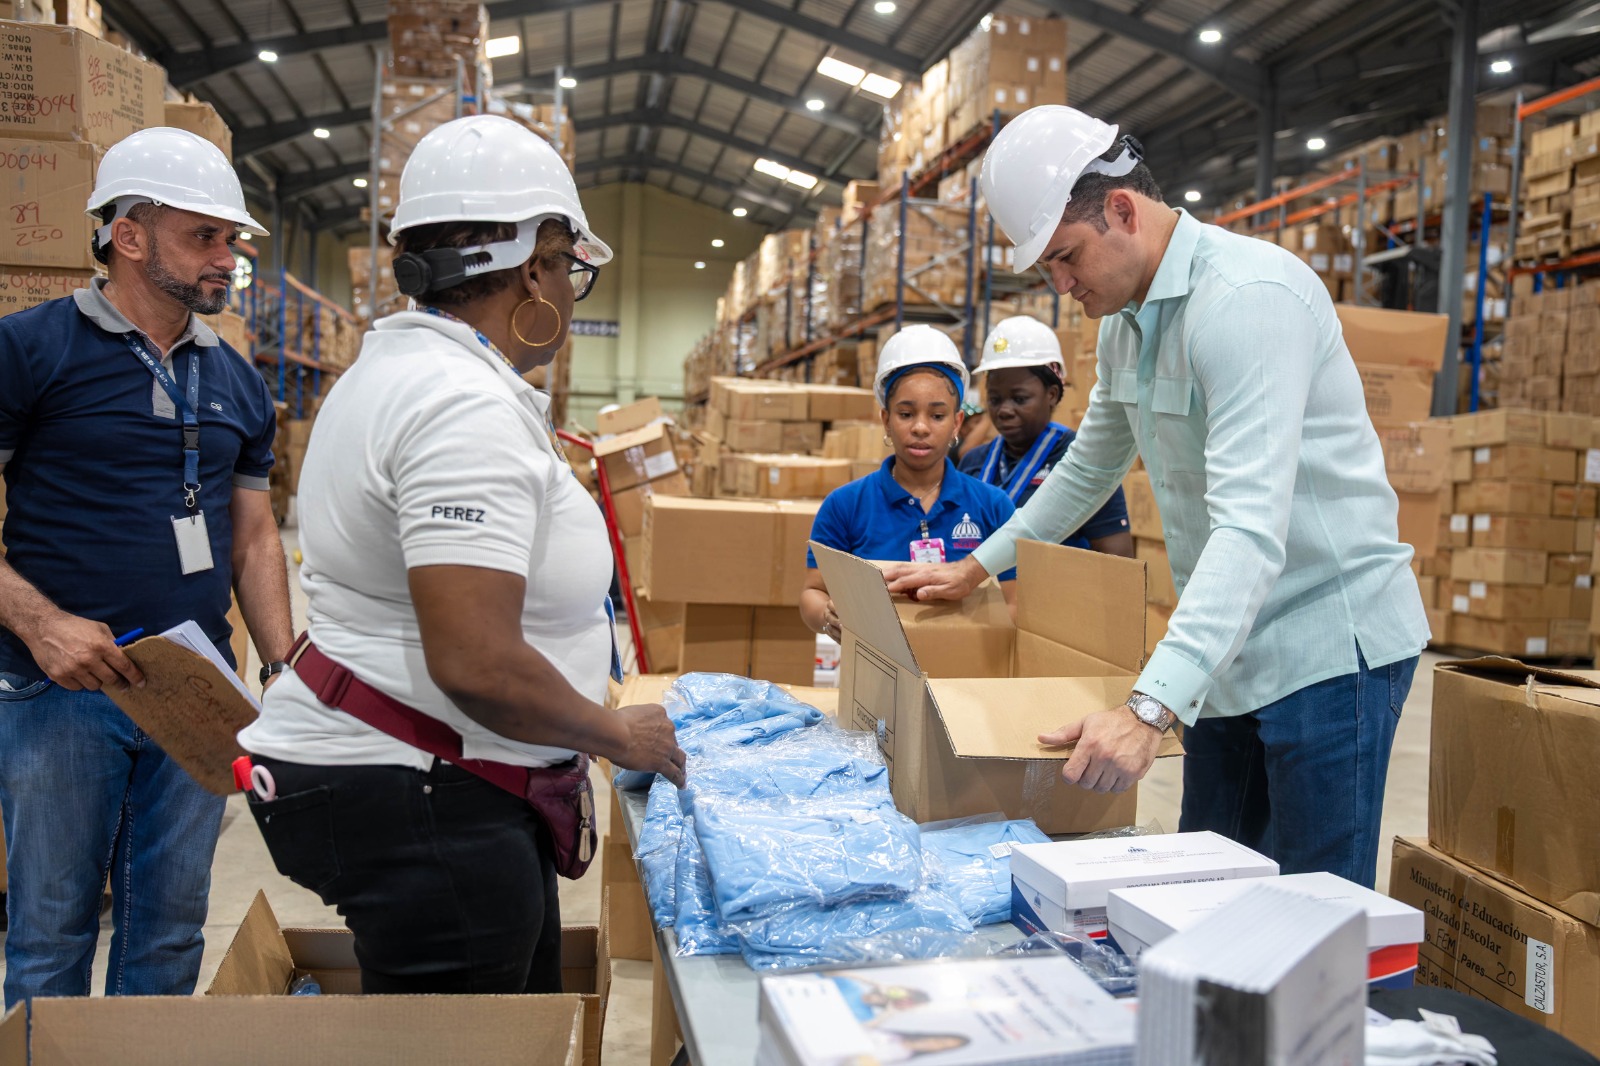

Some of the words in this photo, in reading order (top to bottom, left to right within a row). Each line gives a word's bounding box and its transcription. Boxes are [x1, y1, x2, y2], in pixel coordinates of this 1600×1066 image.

[14, 115, 36, 124] ITEM
[431, 505, 486, 523] PEREZ
[1410, 867, 1456, 905] Ministerio
[1458, 896, 1470, 912] de
[1472, 902, 1528, 945] Educación
[1424, 899, 1460, 931] Calzado
[1462, 921, 1502, 956] Escolar
[1461, 953, 1486, 977] Pares
[1496, 961, 1516, 987] 20
